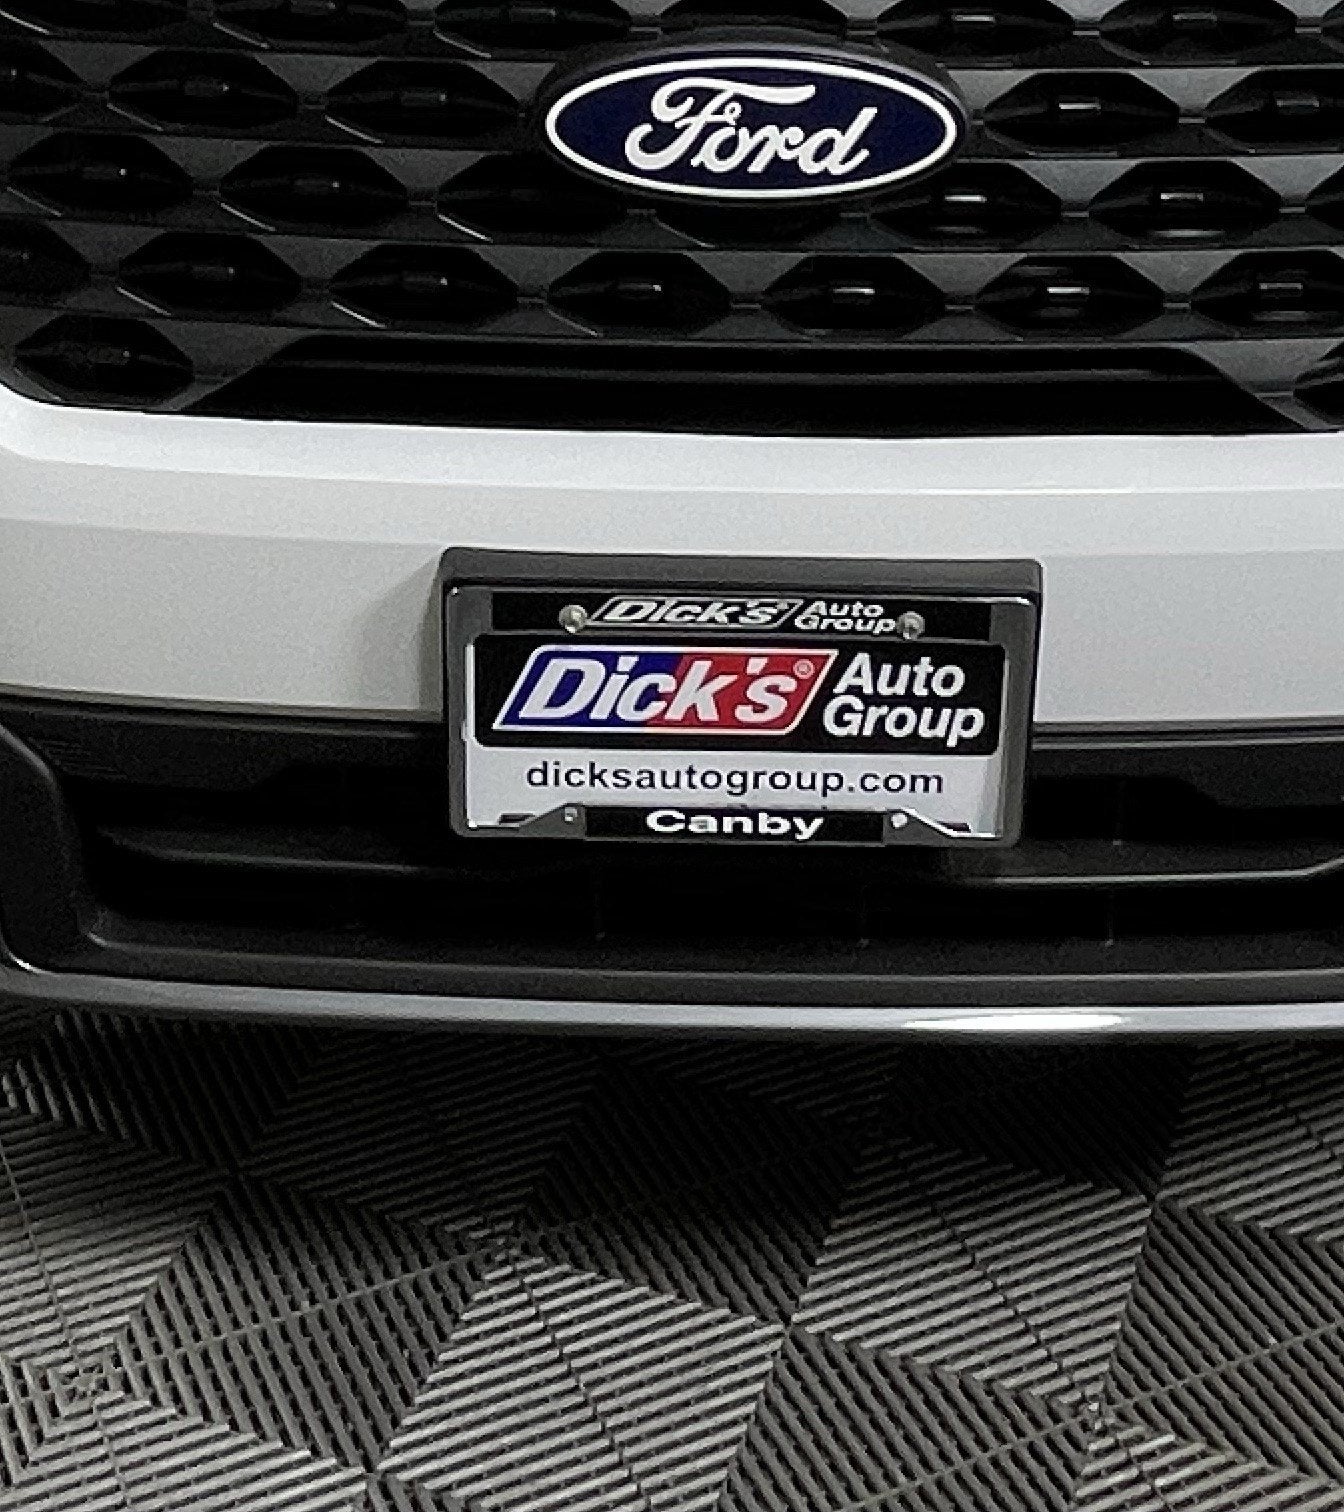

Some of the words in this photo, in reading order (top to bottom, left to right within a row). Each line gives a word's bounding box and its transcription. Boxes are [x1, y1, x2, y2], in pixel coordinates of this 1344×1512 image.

[624, 76, 878, 176] Ford
[794, 616, 896, 634] Group
[806, 600, 884, 618] Auto
[518, 656, 796, 724] Dick's
[832, 652, 965, 697] Auto
[823, 694, 986, 748] Group
[526, 760, 944, 797] dicksautogroup.com
[645, 809, 824, 841] Canby
